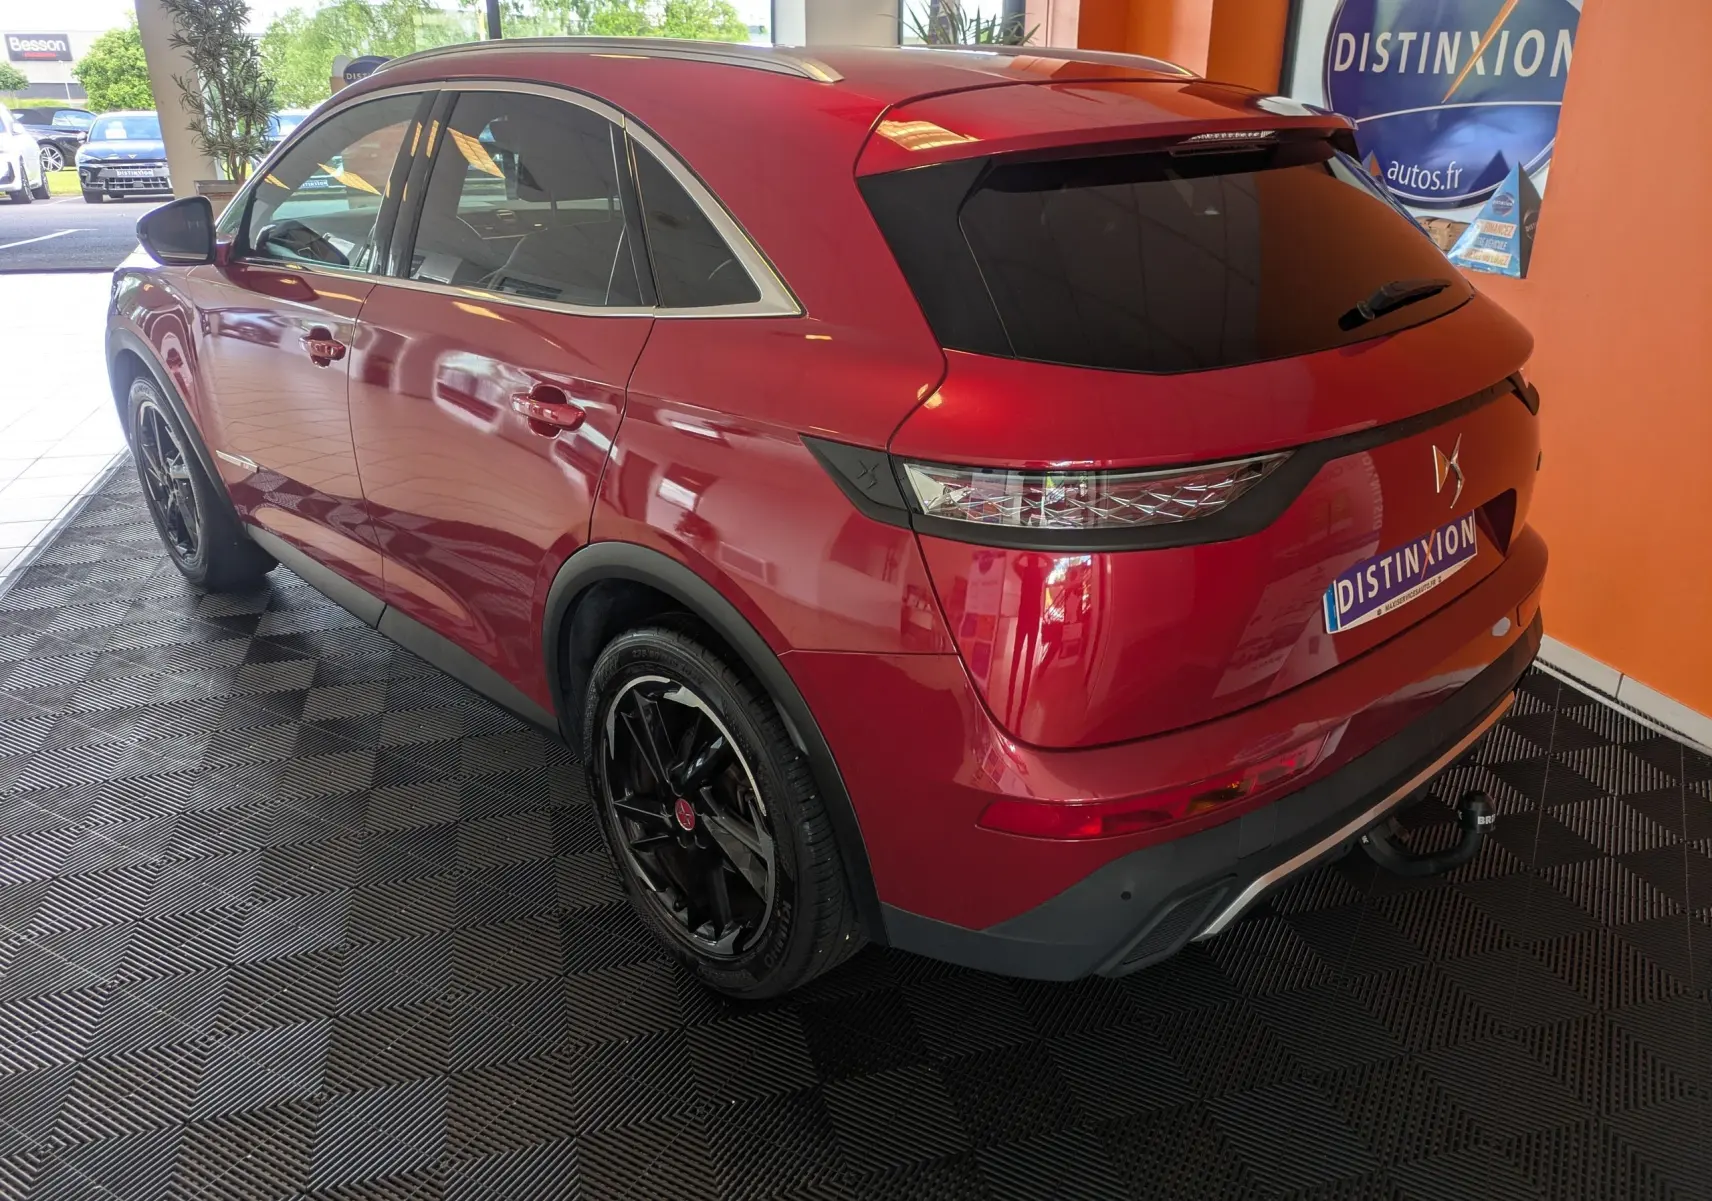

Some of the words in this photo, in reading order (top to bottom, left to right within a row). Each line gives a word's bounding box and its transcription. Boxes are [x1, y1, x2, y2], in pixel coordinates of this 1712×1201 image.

[9, 36, 67, 51] Besson
[1387, 160, 1463, 191] autos.fr
[1338, 515, 1475, 615] DISTINXION
